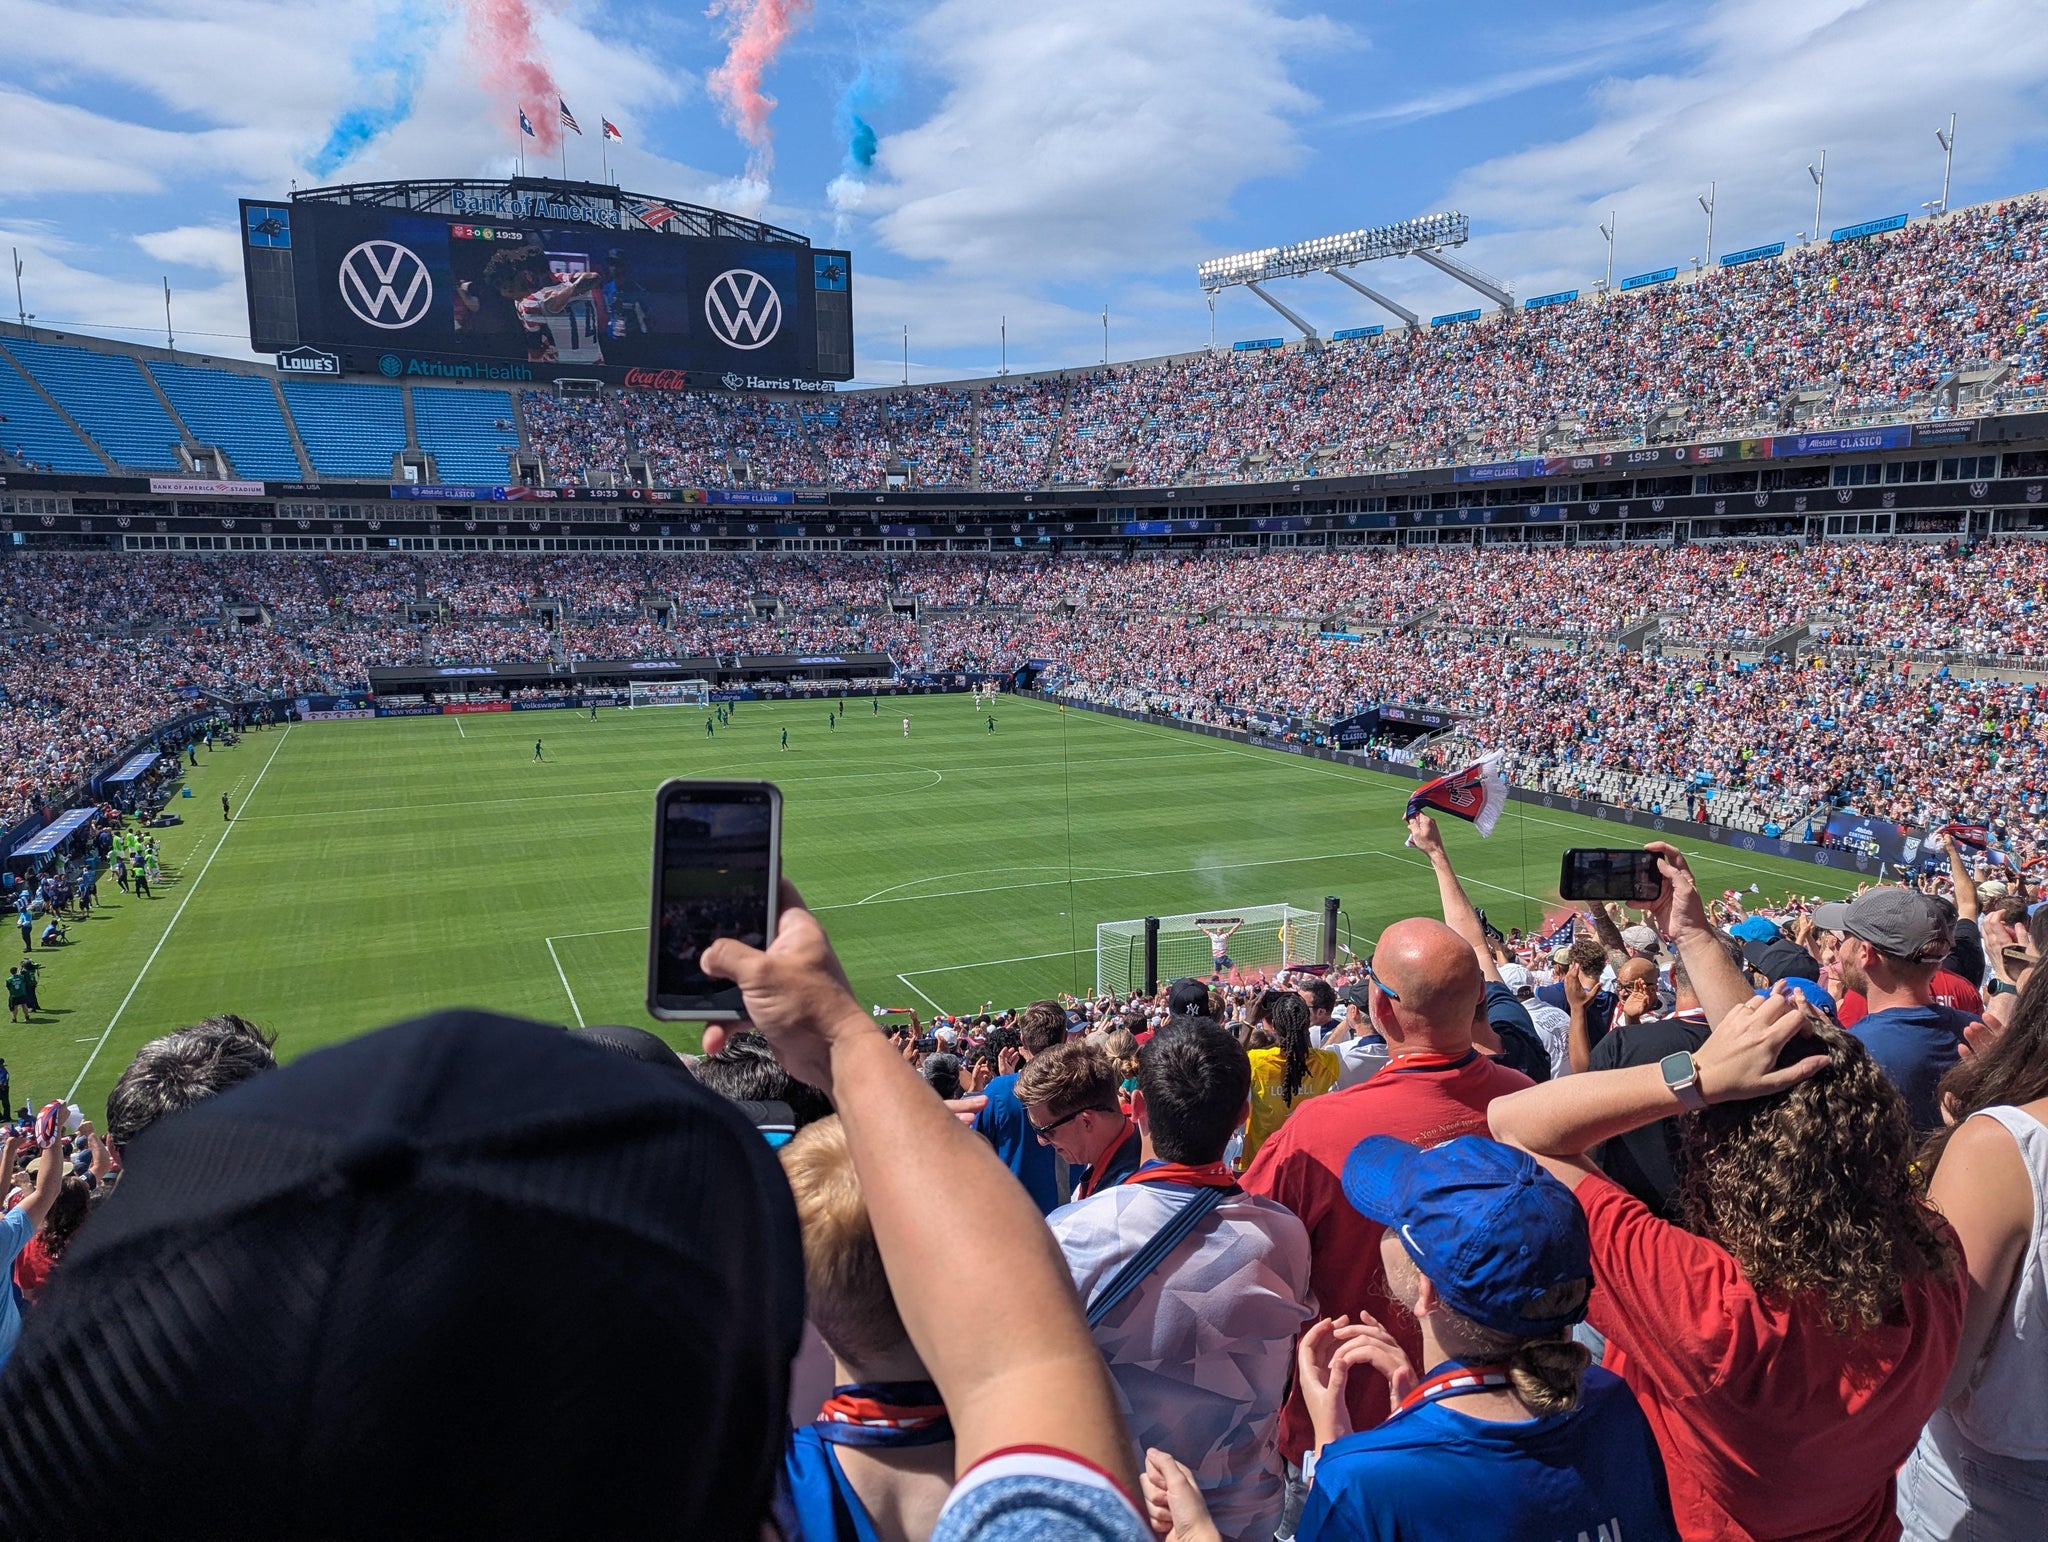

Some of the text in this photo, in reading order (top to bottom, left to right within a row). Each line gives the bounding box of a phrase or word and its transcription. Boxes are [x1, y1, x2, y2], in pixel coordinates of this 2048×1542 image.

[451, 189, 621, 225] Bank of America
[1839, 218, 1897, 239] JULIUS PEPPERS
[496, 230, 523, 241] 19:39
[339, 240, 432, 329] VW
[1629, 272, 1668, 286] WESLEY WALLS
[1530, 299, 1545, 307] STEVE
[705, 269, 782, 350] VW
[282, 355, 333, 372] LOWE'S
[407, 358, 532, 381] Atrium Health
[746, 376, 835, 392] Harris Teeter
[1932, 427, 1960, 435] LOCATION
[1808, 438, 1838, 448] Allstate
[1573, 458, 1594, 469] USA
[1603, 455, 1612, 466] 2
[1628, 451, 1660, 463] 19:39
[1698, 446, 1723, 459] SEN
[536, 490, 557, 498] USA
[567, 489, 576, 498] 2
[590, 490, 618, 498] 19:39
[651, 491, 671, 500] SEN
[632, 661, 682, 669] GOAL
[798, 655, 846, 664] GOAL
[441, 667, 497, 675] GOAL
[521, 701, 566, 710] Volkswagen
[597, 699, 616, 707] SOCCER
[649, 696, 685, 706] Chobani
[389, 707, 437, 716] NEW YORK LIFE
[467, 704, 489, 713] Henkel
[1389, 709, 1405, 719] USA
[1421, 714, 1440, 724] 19:39
[1250, 736, 1263, 746] USA
[1289, 745, 1301, 754] SEN
[1186, 1003, 1200, 1017] NY
[1271, 1084, 1315, 1097] LOELL
[1420, 1128, 1437, 1139] You
[1438, 1120, 1460, 1132] Need
